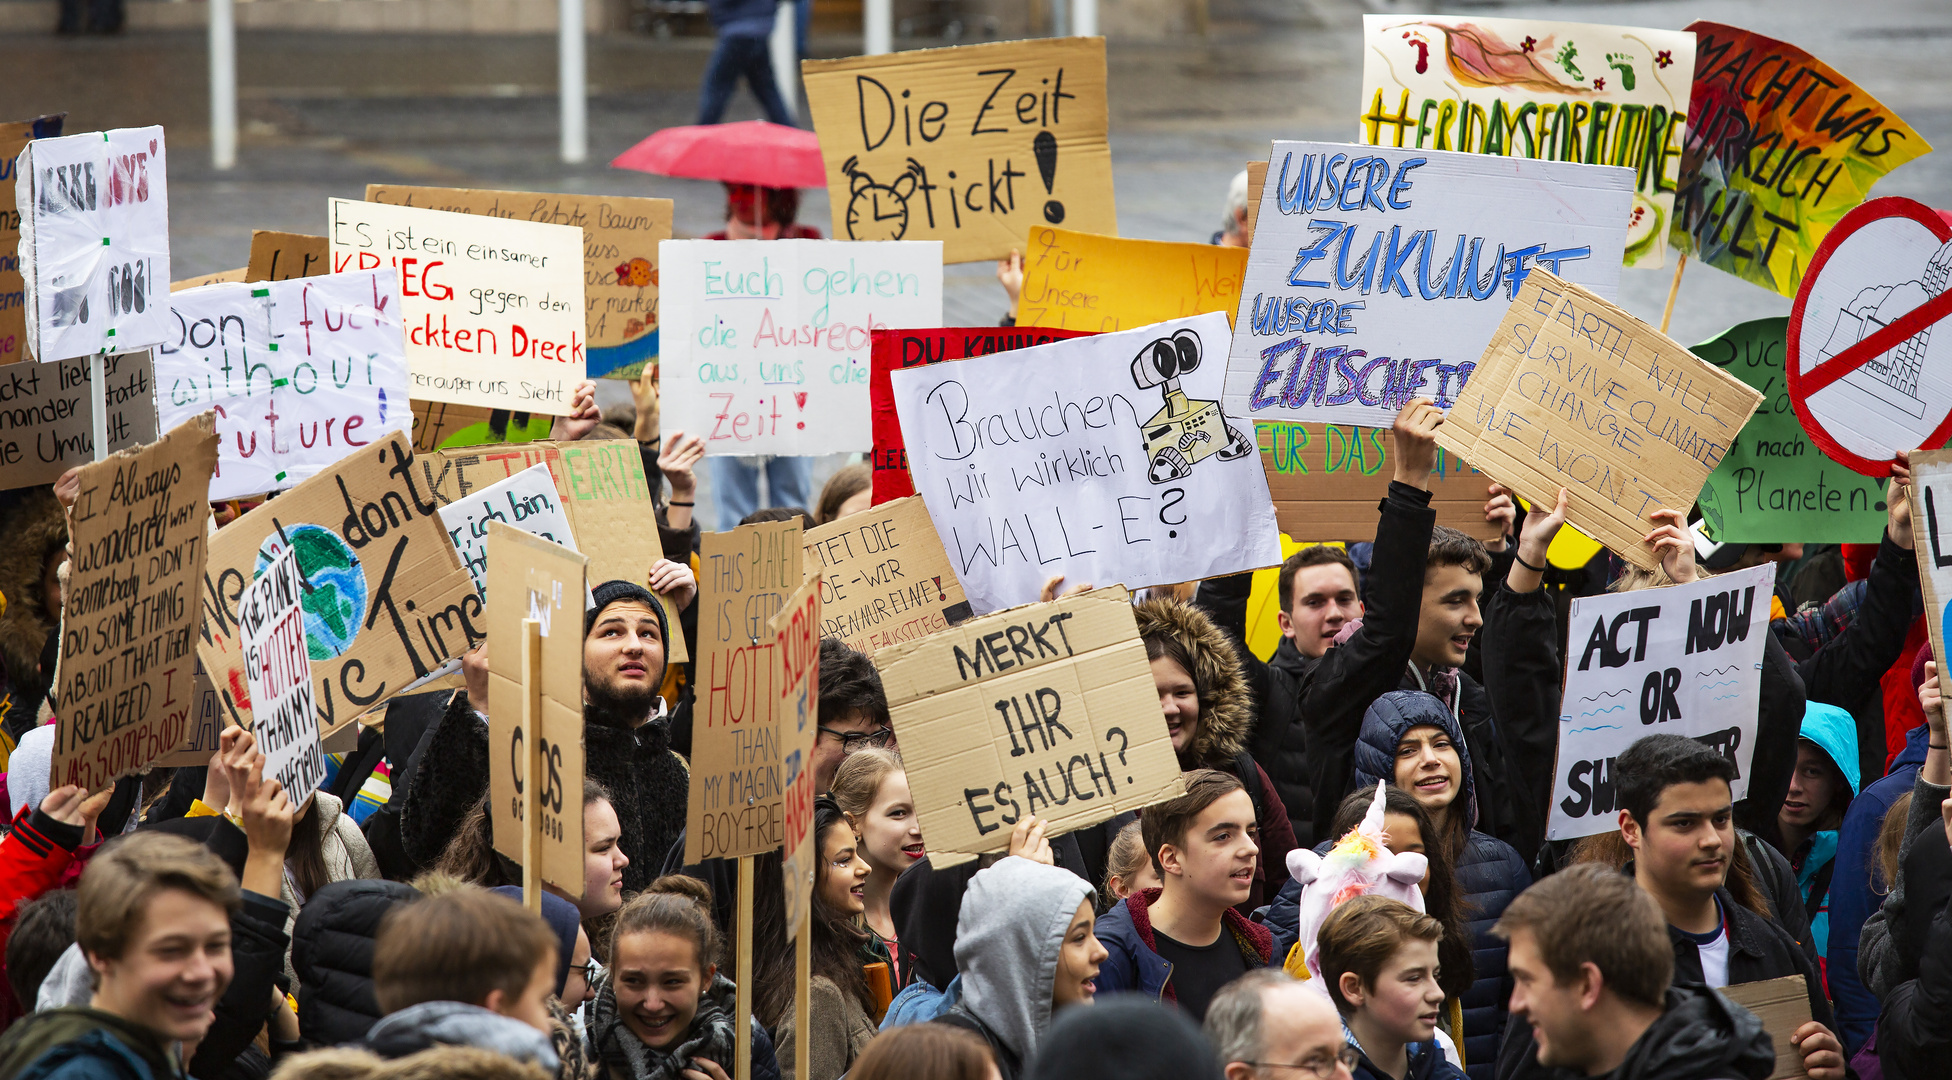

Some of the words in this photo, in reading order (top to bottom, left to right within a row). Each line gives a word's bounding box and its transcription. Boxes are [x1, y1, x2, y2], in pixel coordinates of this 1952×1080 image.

[857, 75, 948, 151] Die
[971, 68, 1076, 136] Zeit
[1697, 35, 1839, 117] MACHT
[1815, 94, 1906, 156] WAS
[386, 226, 414, 252] ist
[422, 237, 457, 256] ein
[466, 239, 549, 269] einsamer
[599, 203, 653, 231] Baum
[300, 274, 389, 356] fuck
[334, 251, 454, 301] KREG
[468, 287, 529, 316] gegen
[539, 291, 571, 313] den
[703, 256, 784, 296] Euch
[803, 257, 919, 328] gehen
[1023, 270, 1099, 310] Unsere
[512, 324, 584, 364] Dreck
[698, 314, 738, 349] die
[902, 336, 946, 368] DU
[963, 334, 1068, 358] KAN
[1534, 287, 1632, 368] EARTH
[1647, 353, 1728, 428] WILL
[171, 346, 276, 406] with
[293, 353, 378, 395] our
[478, 380, 508, 395] uns
[698, 361, 747, 385] aus,
[759, 360, 806, 385] uns
[829, 357, 869, 384] die
[1508, 324, 1627, 411] SURVIVE
[1629, 400, 1726, 472] CLIMATE
[708, 391, 809, 441] Zeit!
[926, 379, 1141, 461] Brauchen
[1254, 421, 1311, 475] FÜR
[1325, 423, 1386, 476] DAS
[1756, 433, 1805, 457] nach
[565, 444, 650, 501] EARTH
[946, 464, 990, 510] wir
[1011, 445, 1125, 492] wirklich
[1476, 394, 1531, 439] WE
[1538, 429, 1662, 520] WON'T
[80, 486, 99, 522] I
[104, 461, 181, 516] Always
[336, 440, 436, 549] don't
[78, 493, 171, 573] wondered
[170, 501, 196, 528] WHY
[148, 536, 199, 585] DIDN'T
[710, 552, 744, 594] THIS
[750, 527, 798, 591] PLANET
[860, 519, 900, 554] DIE
[66, 626, 89, 659] DO
[94, 581, 184, 656] SOMETHING
[241, 586, 265, 640] THE
[261, 550, 298, 624] PLANET
[366, 535, 488, 679] Time
[717, 599, 733, 642] IS
[889, 575, 947, 616] EINE!
[246, 645, 261, 681] IS
[260, 606, 308, 701] HOTTER
[953, 612, 1073, 681] MERKT
[1577, 605, 1661, 671] ACT
[1685, 585, 1755, 655] NOW
[61, 656, 117, 710] ABOUT
[121, 635, 163, 684] THAT
[709, 643, 775, 728] HOTT
[1640, 667, 1682, 725] OR
[59, 719, 64, 755] I
[71, 681, 151, 752] REALIZED
[162, 668, 177, 708] I
[257, 699, 294, 755] THAN
[291, 681, 313, 739] MY
[995, 687, 1073, 757] IHR
[731, 726, 779, 766] THAN
[704, 775, 724, 811] MY
[728, 765, 783, 807] IMAGIN
[964, 781, 1020, 836] ES
[701, 802, 785, 858] BOYFRIE
